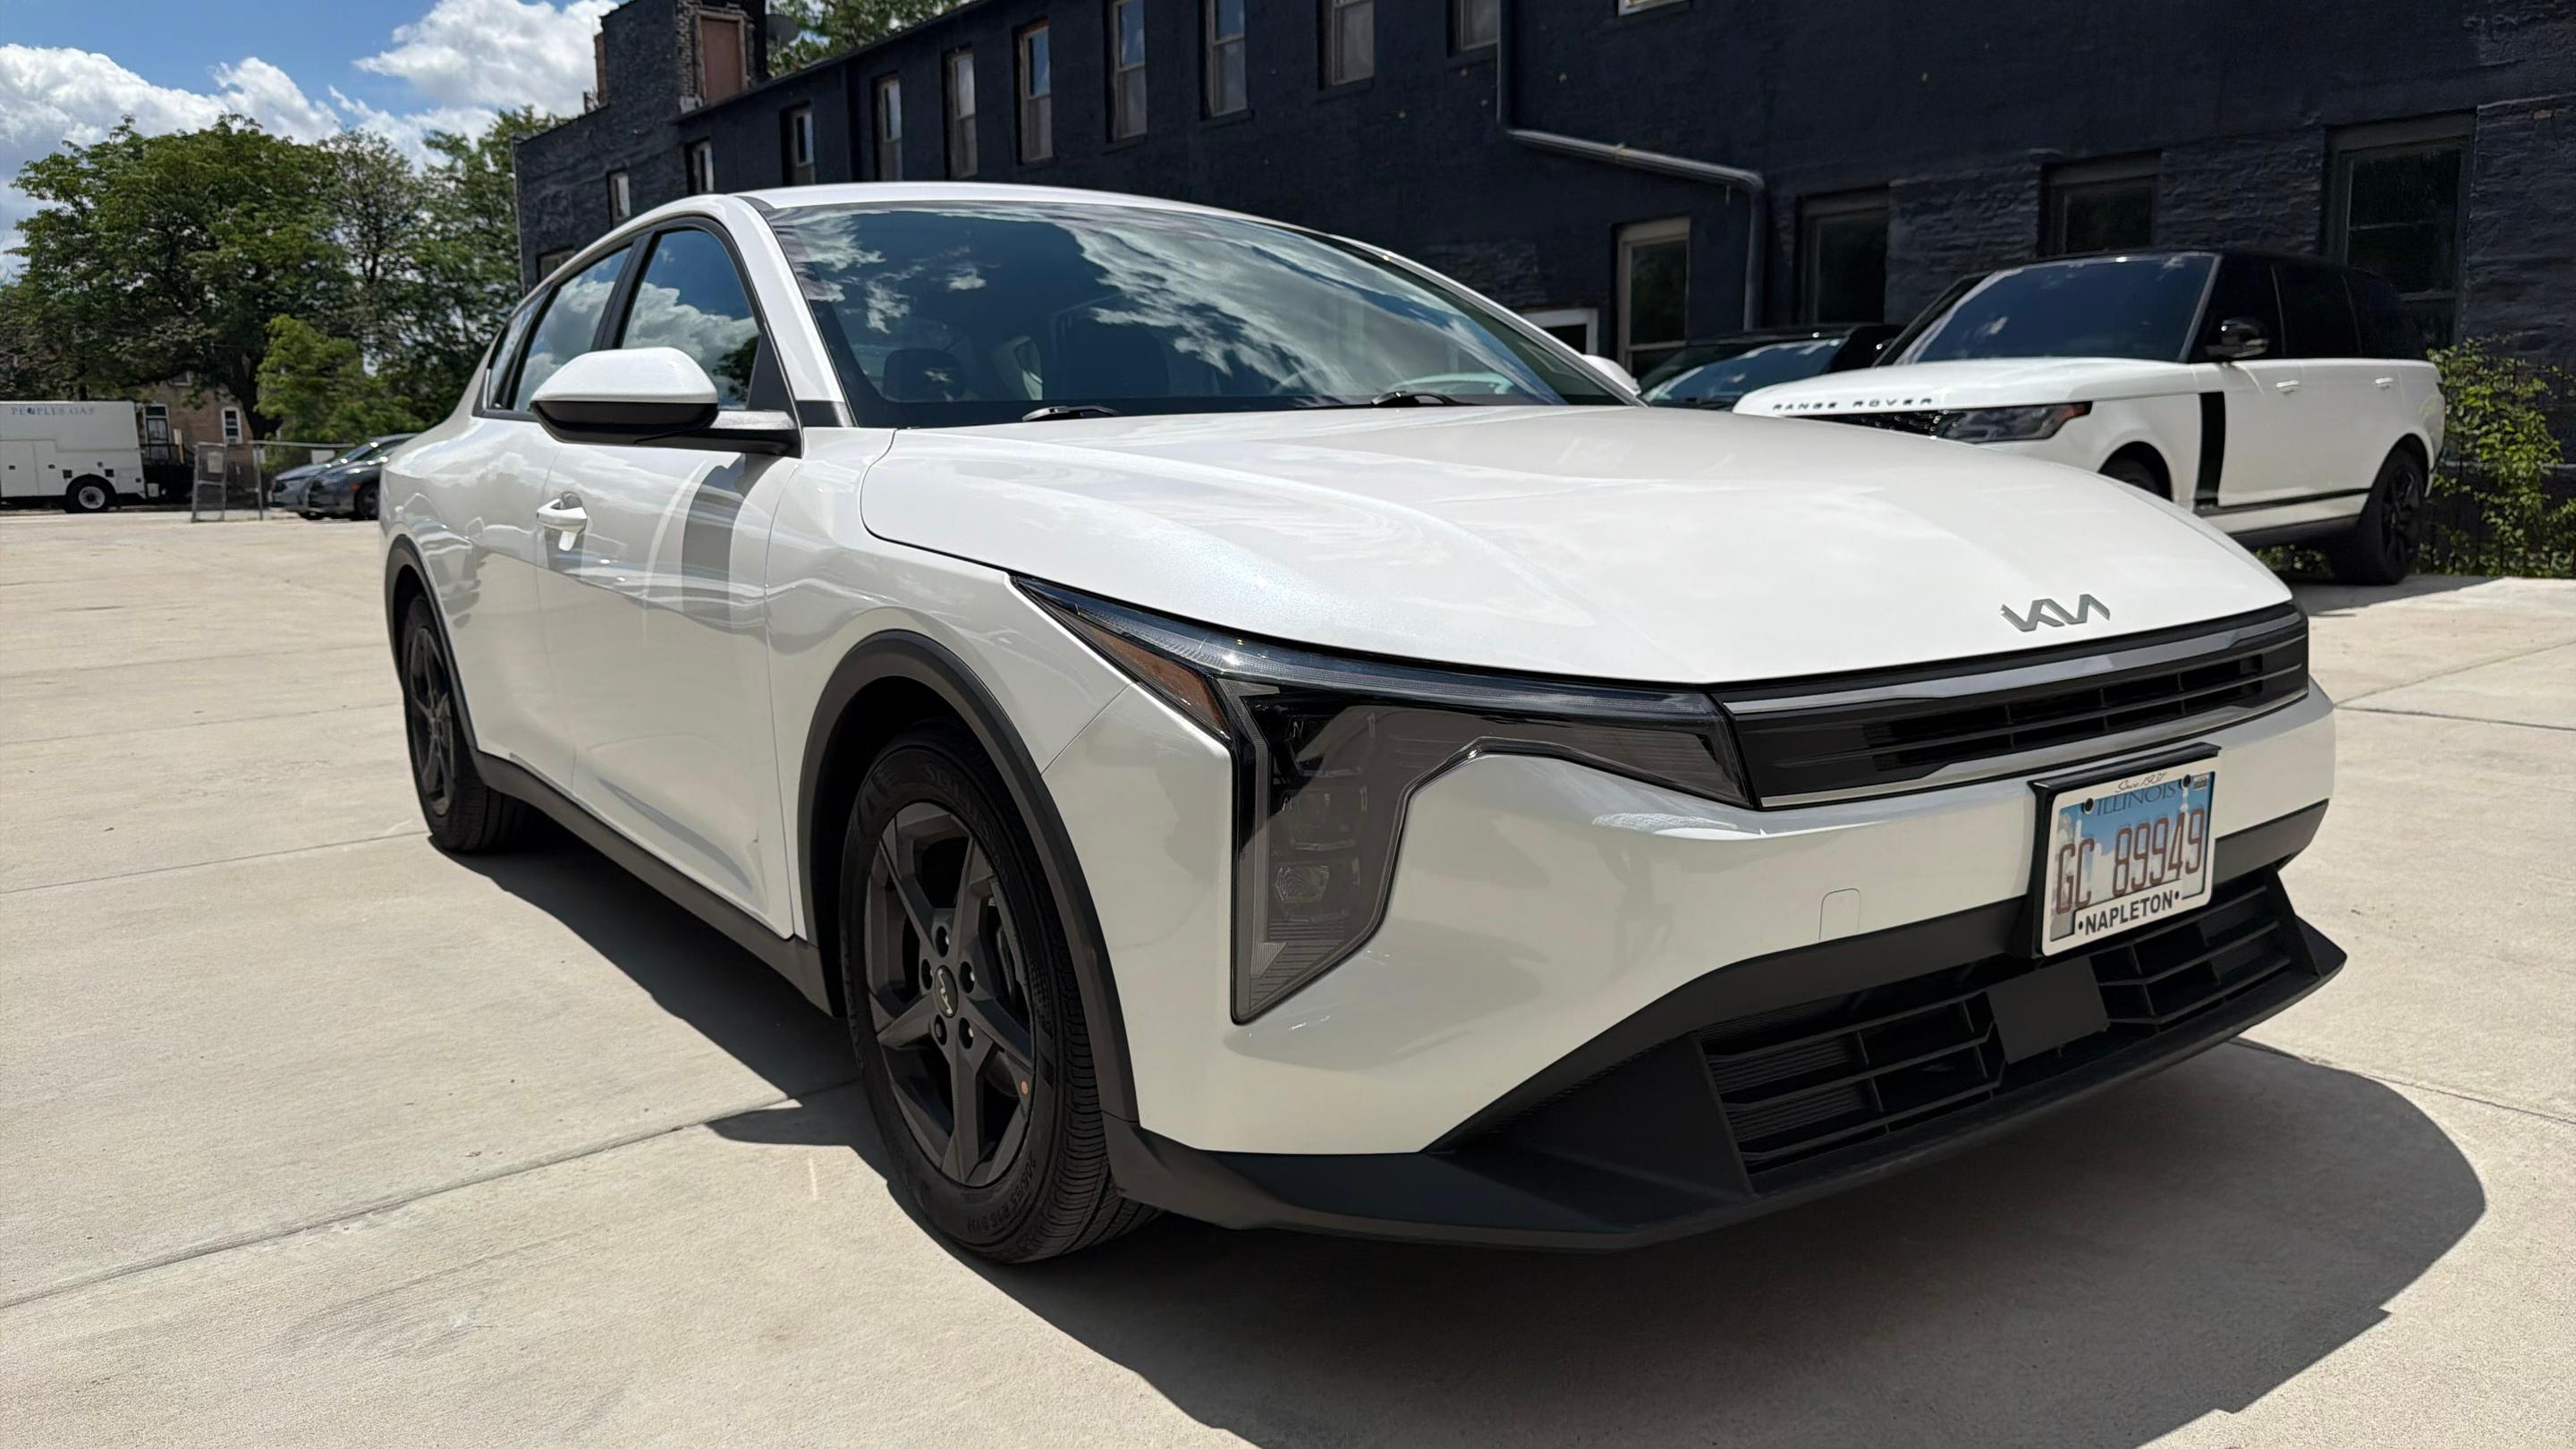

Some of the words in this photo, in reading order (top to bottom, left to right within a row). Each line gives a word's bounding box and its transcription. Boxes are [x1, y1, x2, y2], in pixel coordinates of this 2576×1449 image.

[1773, 402, 1838, 411] RANGE
[1852, 397, 1933, 408] ROVER
[2001, 594, 2111, 632] KIA
[2096, 784, 2177, 817] ILLINOIS
[2055, 837, 2096, 915] GC
[2112, 808, 2206, 898] 89949
[2084, 889, 2174, 936] NAPLETON
